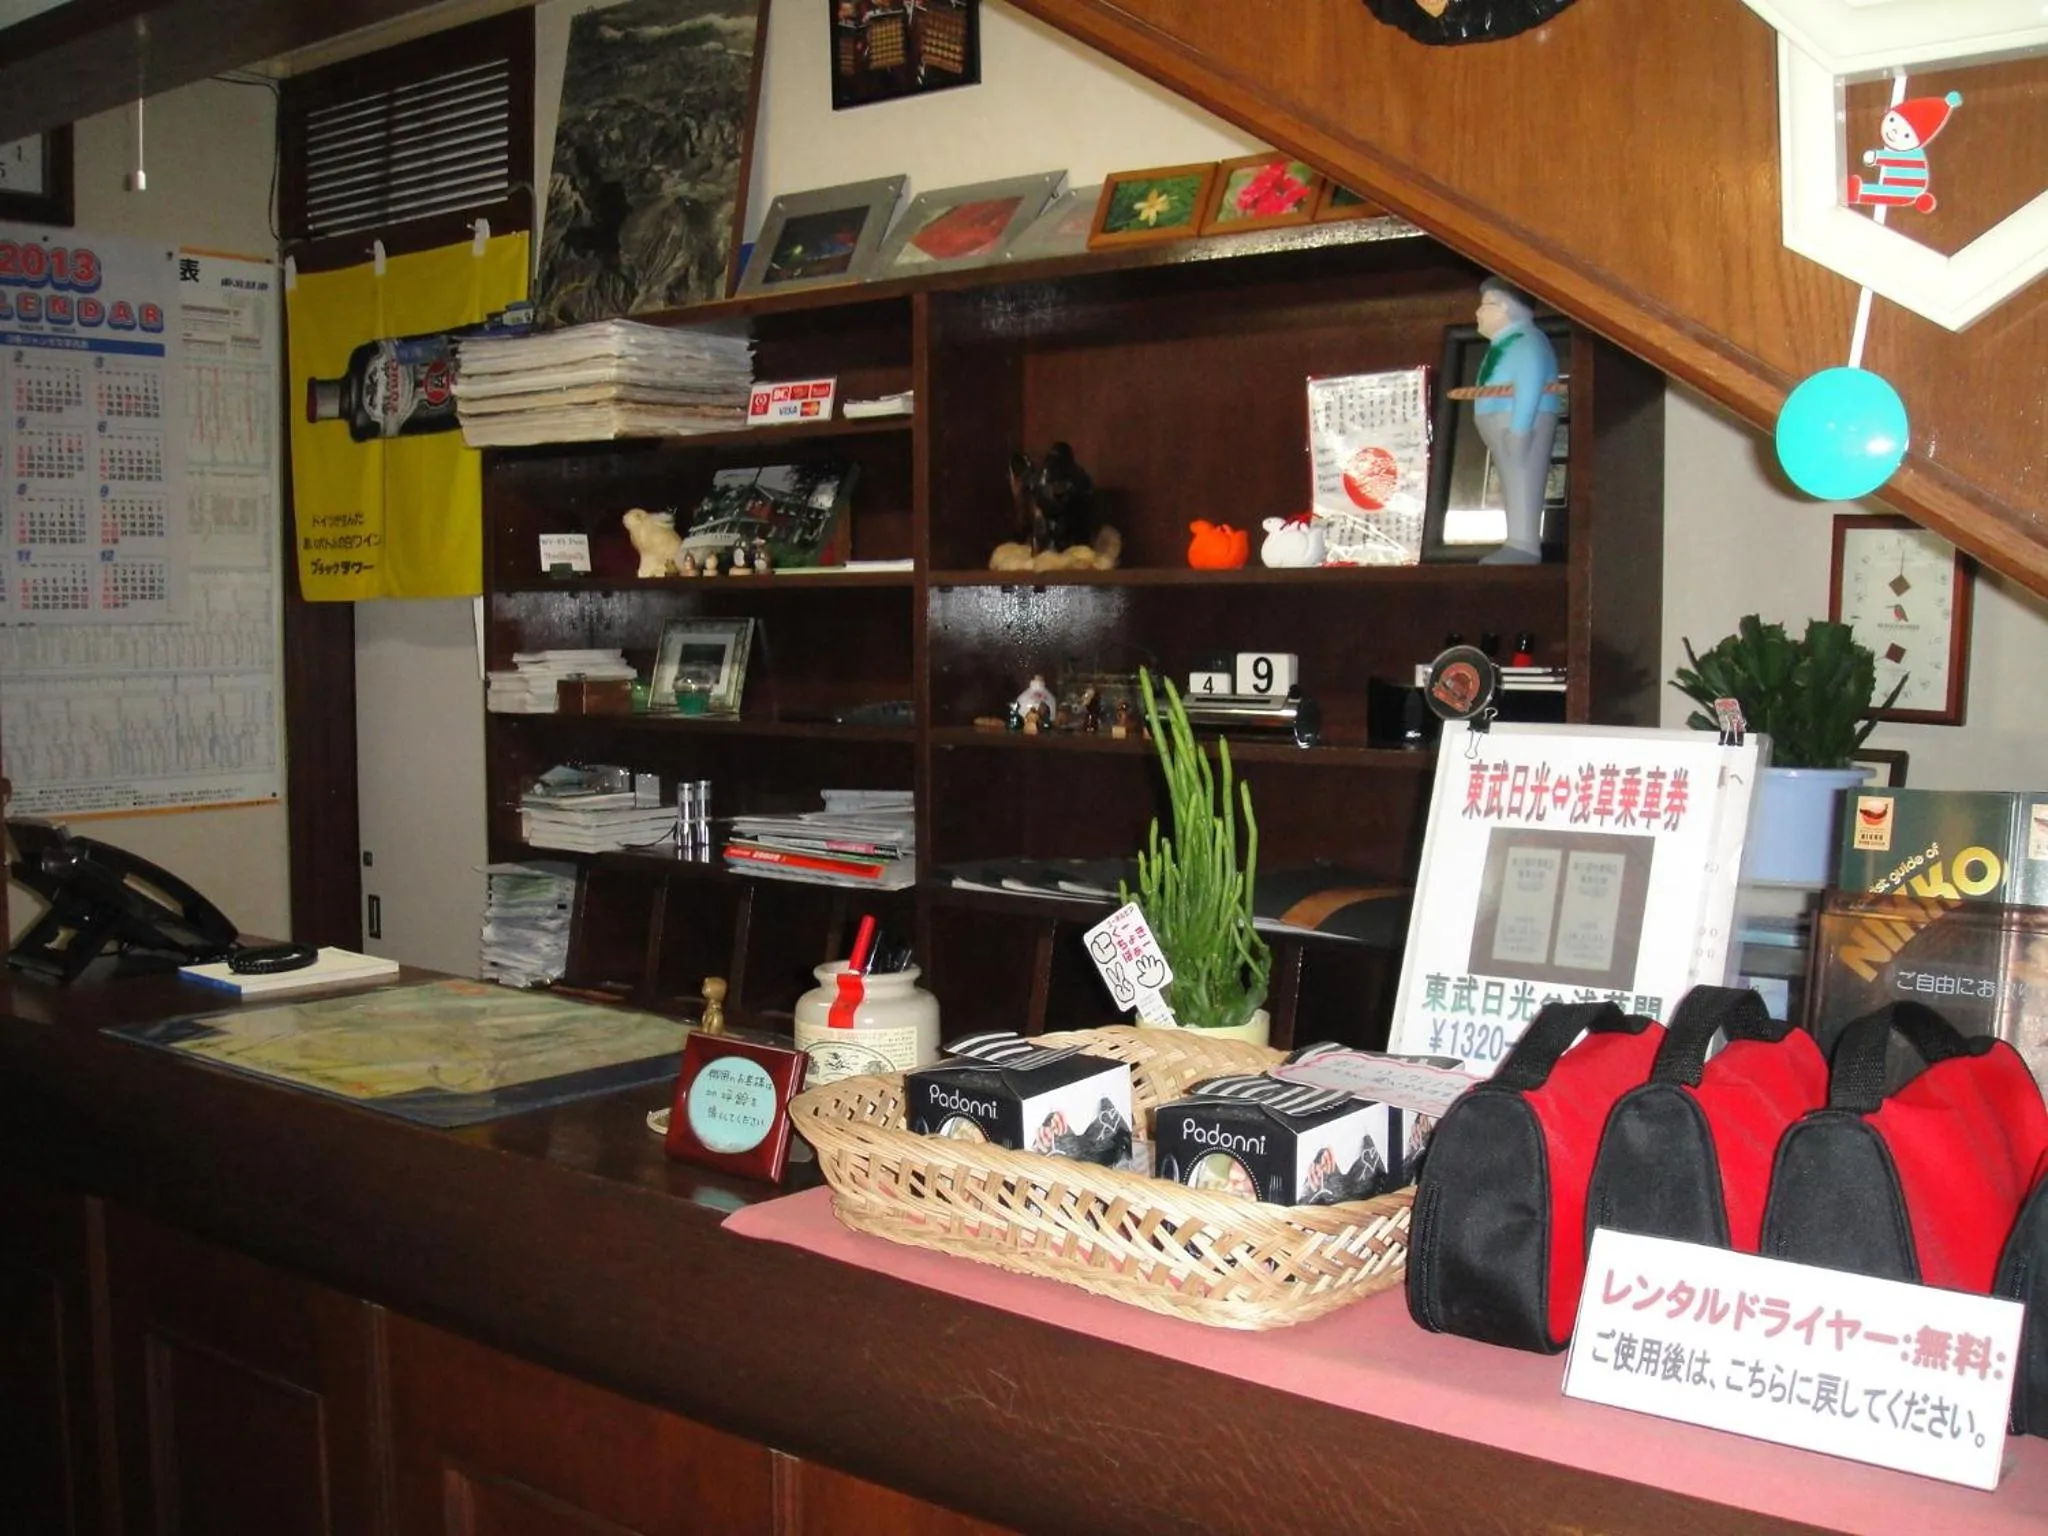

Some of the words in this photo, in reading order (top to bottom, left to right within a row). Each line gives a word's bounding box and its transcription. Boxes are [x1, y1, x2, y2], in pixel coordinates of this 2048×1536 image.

[0, 239, 101, 293] 2013
[1203, 676, 1214, 695] 4
[1252, 656, 1274, 694] 9
[1888, 855, 1925, 885] guide
[928, 1083, 999, 1120] Padonni
[1182, 1117, 1267, 1156] Padonni
[1592, 1330, 1986, 1449] ご使用後は、こちらに戻してください。
